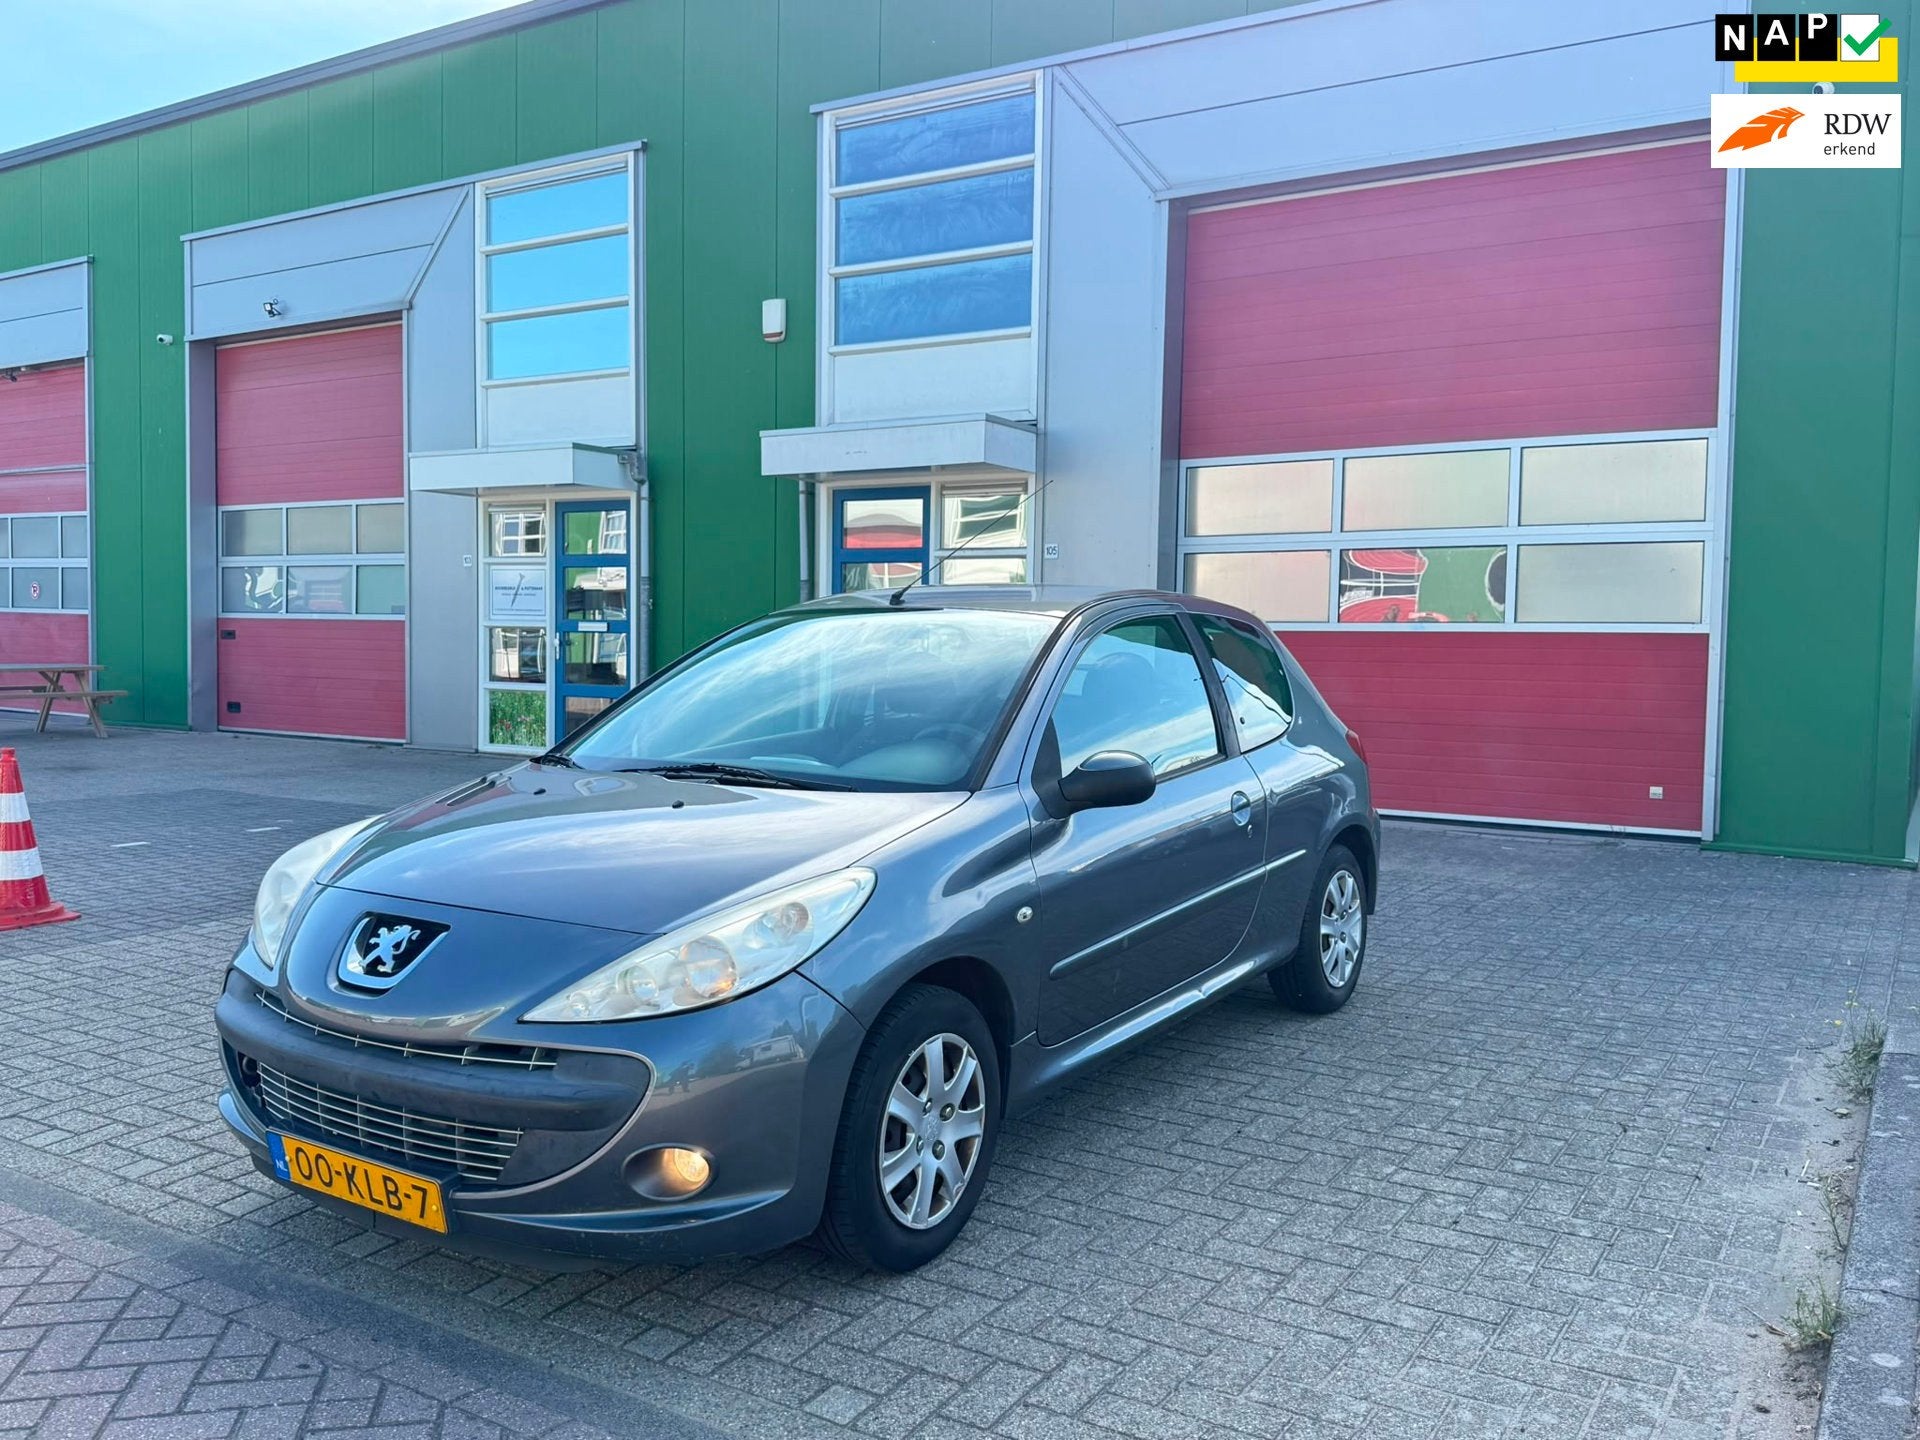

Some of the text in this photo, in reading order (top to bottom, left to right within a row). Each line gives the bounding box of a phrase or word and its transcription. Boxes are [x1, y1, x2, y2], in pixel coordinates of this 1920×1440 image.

[1046, 546, 1057, 555] 105
[275, 1146, 428, 1219] NL 00-KLB-7
